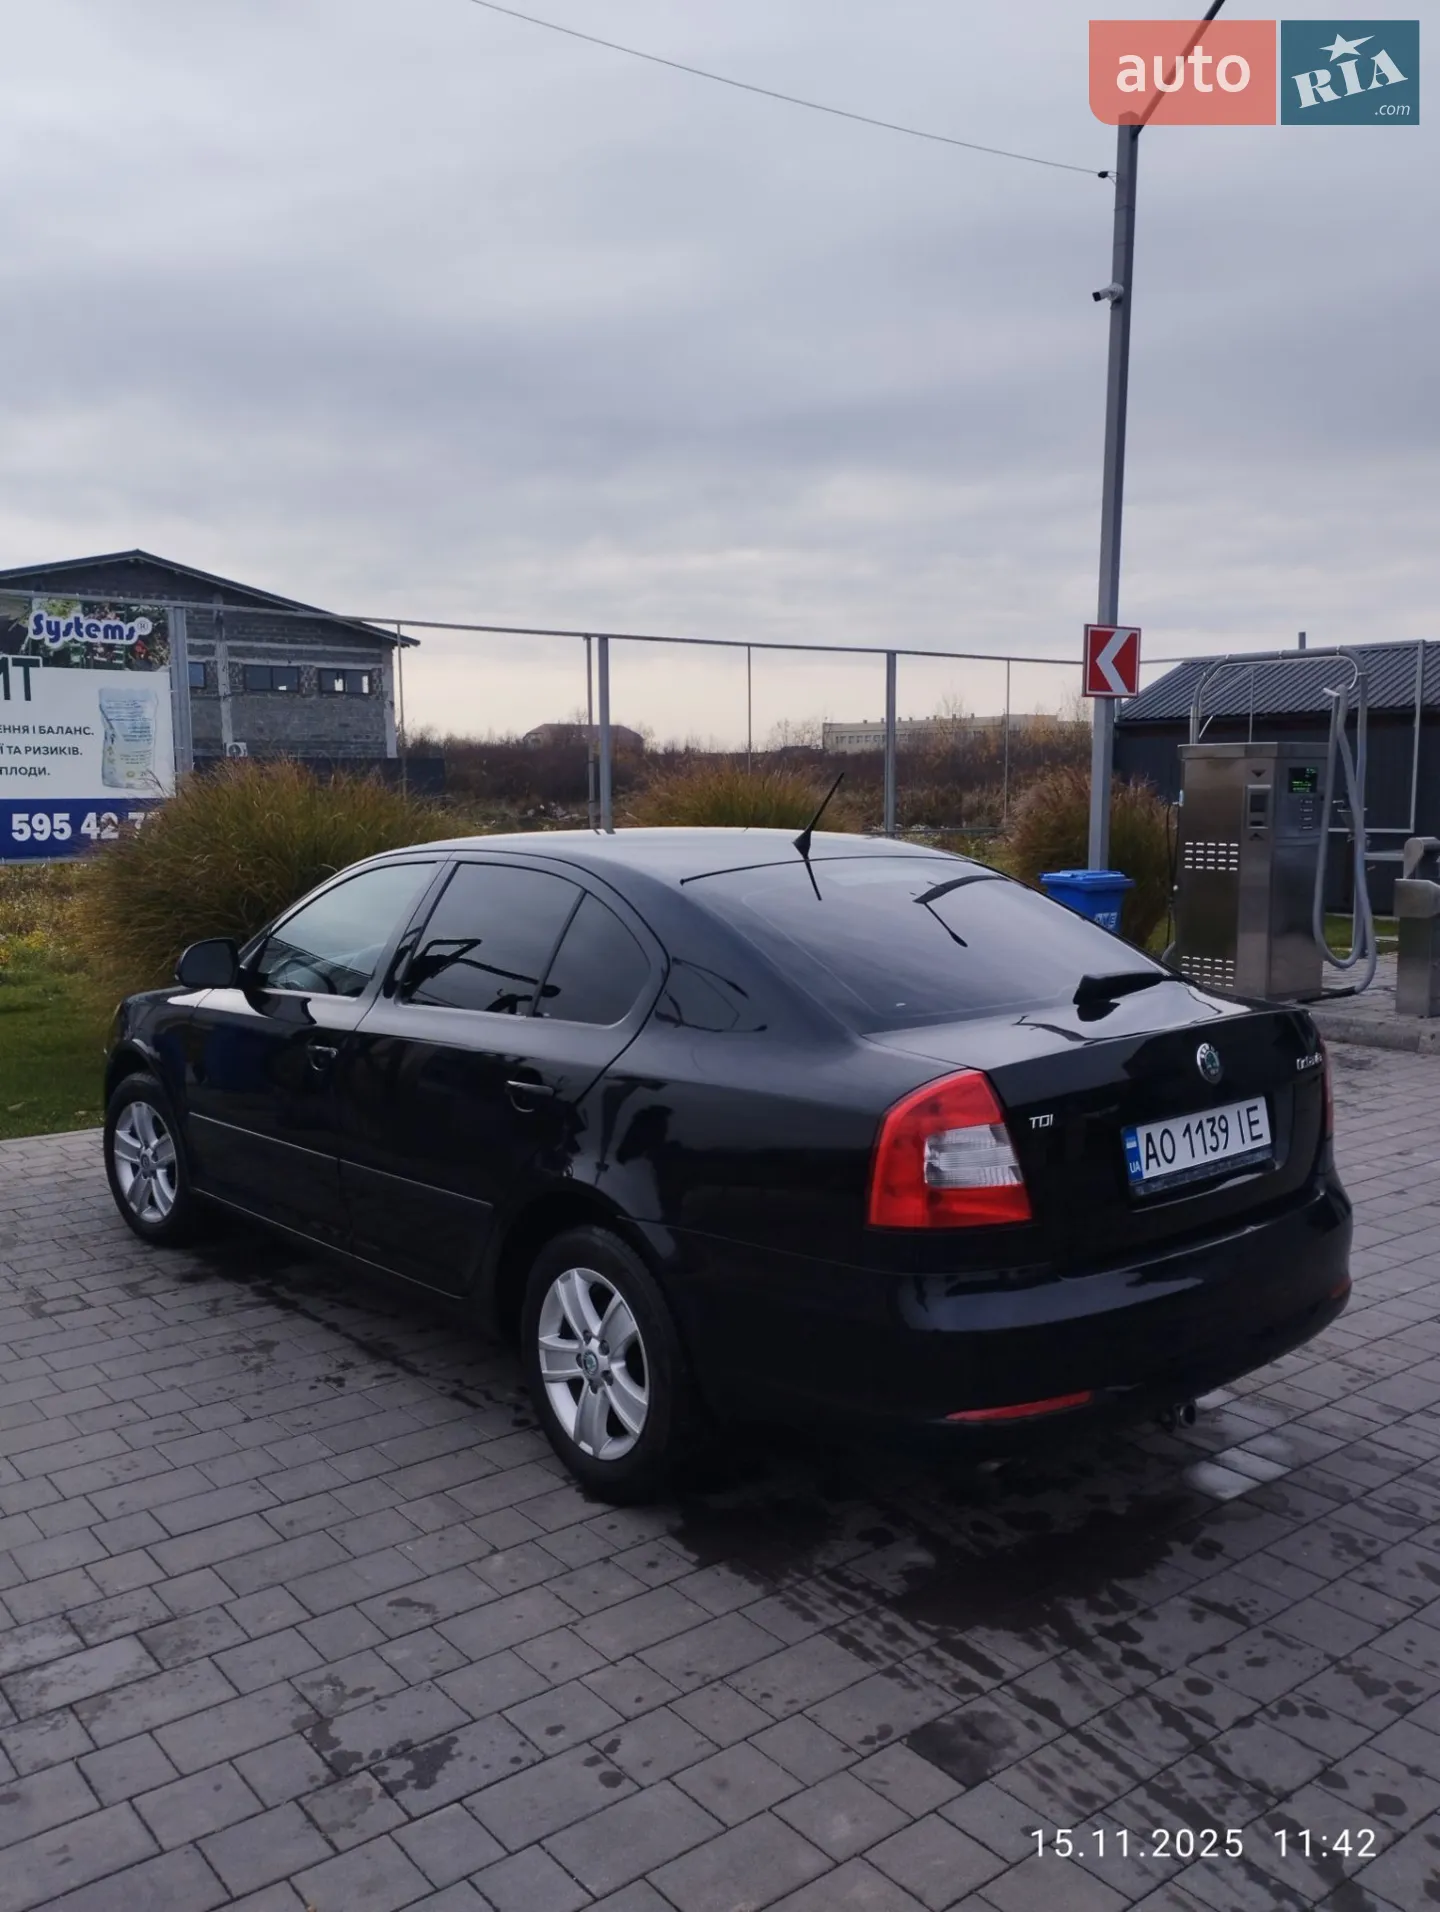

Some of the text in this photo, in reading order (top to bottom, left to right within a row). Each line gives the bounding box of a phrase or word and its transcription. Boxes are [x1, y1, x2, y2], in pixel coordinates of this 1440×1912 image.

[33, 613, 136, 643] Systems
[39, 725, 94, 736] БАЛАНС.
[6, 745, 22, 755] ТА
[25, 746, 83, 756] РИЗИКІВ.
[12, 813, 72, 841] 595
[81, 812, 118, 839] 42
[1029, 1113, 1054, 1129] TDI
[1145, 1105, 1263, 1170] AO 1139 IE
[1129, 1162, 1141, 1173] UA
